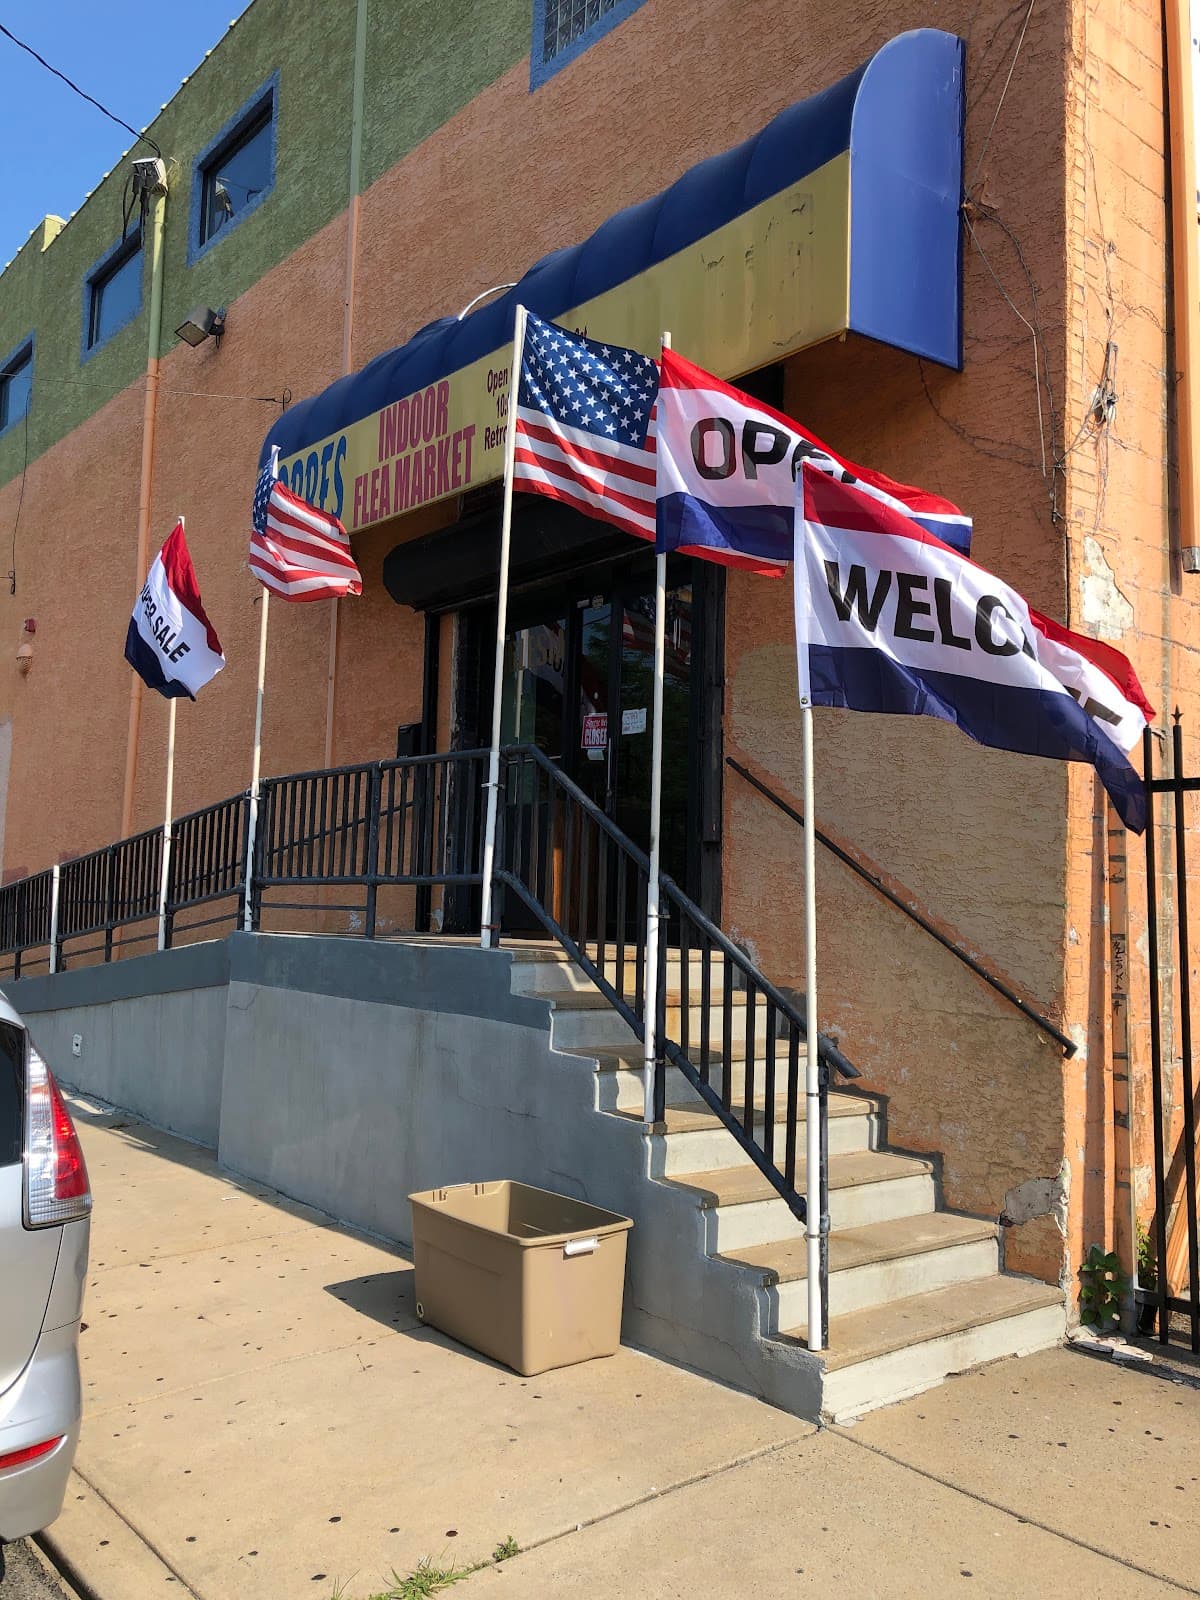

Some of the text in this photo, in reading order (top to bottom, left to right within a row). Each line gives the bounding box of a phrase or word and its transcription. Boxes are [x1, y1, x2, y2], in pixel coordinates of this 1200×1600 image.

[487, 368, 508, 397] Open
[378, 380, 449, 463] INDOOR
[353, 424, 475, 529] FLEA MARKET
[152, 615, 191, 664] SALE
